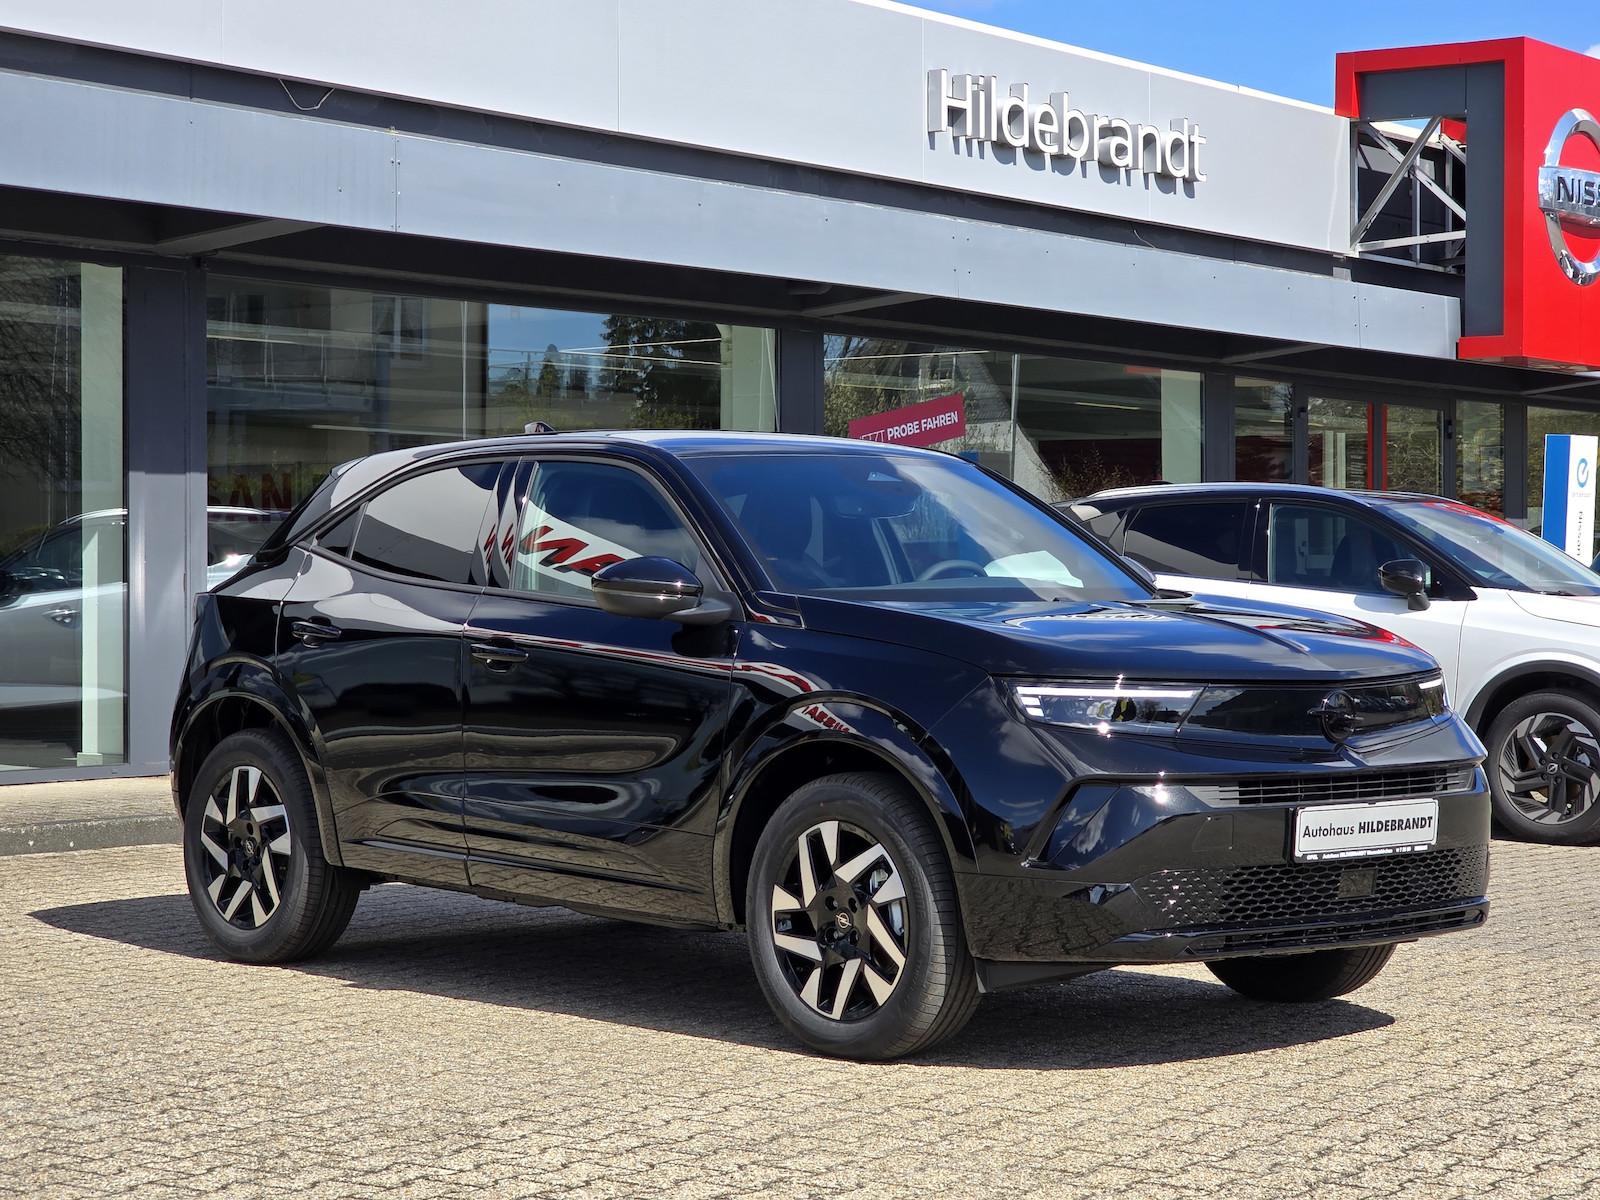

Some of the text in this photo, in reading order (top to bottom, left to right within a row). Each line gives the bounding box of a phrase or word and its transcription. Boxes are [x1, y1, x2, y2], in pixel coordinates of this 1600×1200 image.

[928, 69, 1207, 182] Hildebrandt
[1556, 176, 1600, 207] NIS
[887, 421, 920, 440] PROBE
[921, 411, 959, 431] FAHREN
[1302, 816, 1433, 838] Autohaus HILDEBRANDT
